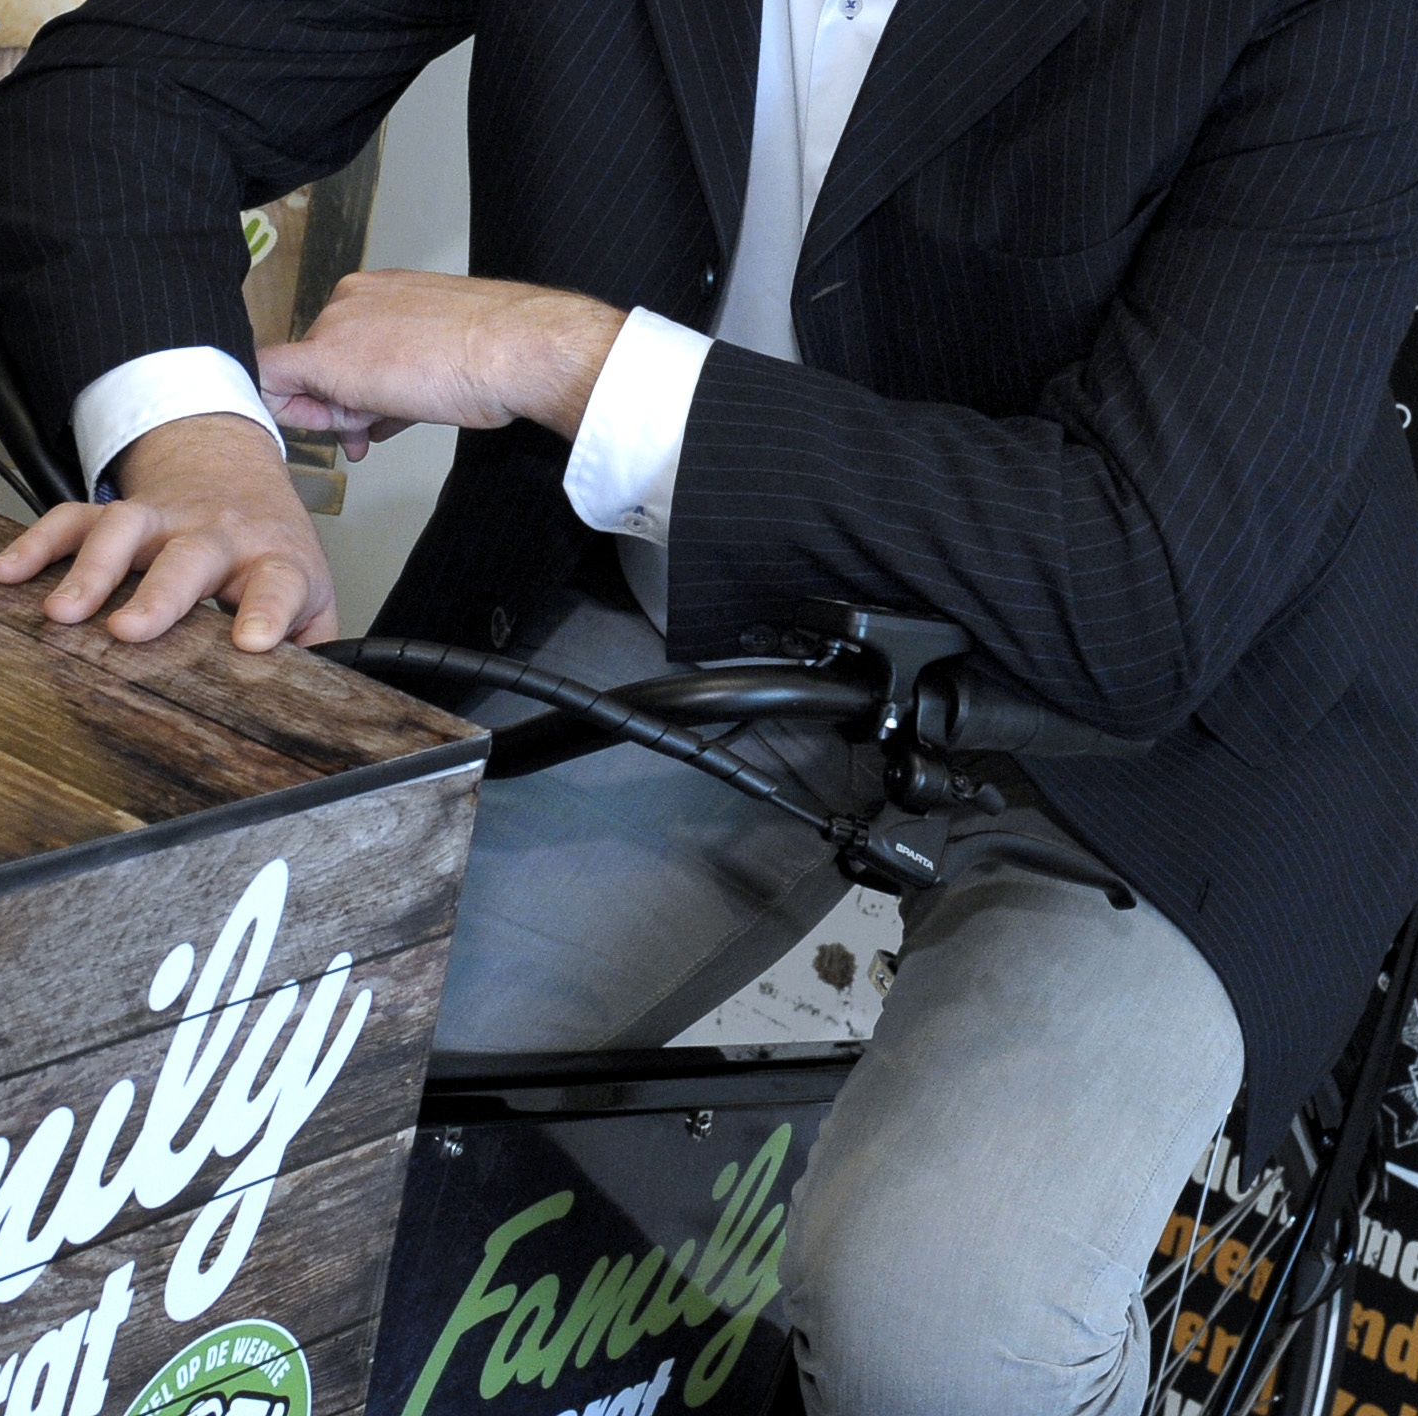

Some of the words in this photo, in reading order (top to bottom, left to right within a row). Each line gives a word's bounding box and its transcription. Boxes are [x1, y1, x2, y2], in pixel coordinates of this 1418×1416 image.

[400, 1123, 792, 1416] Family
[176, 1355, 201, 1391] OP
[204, 1340, 230, 1373] DE
